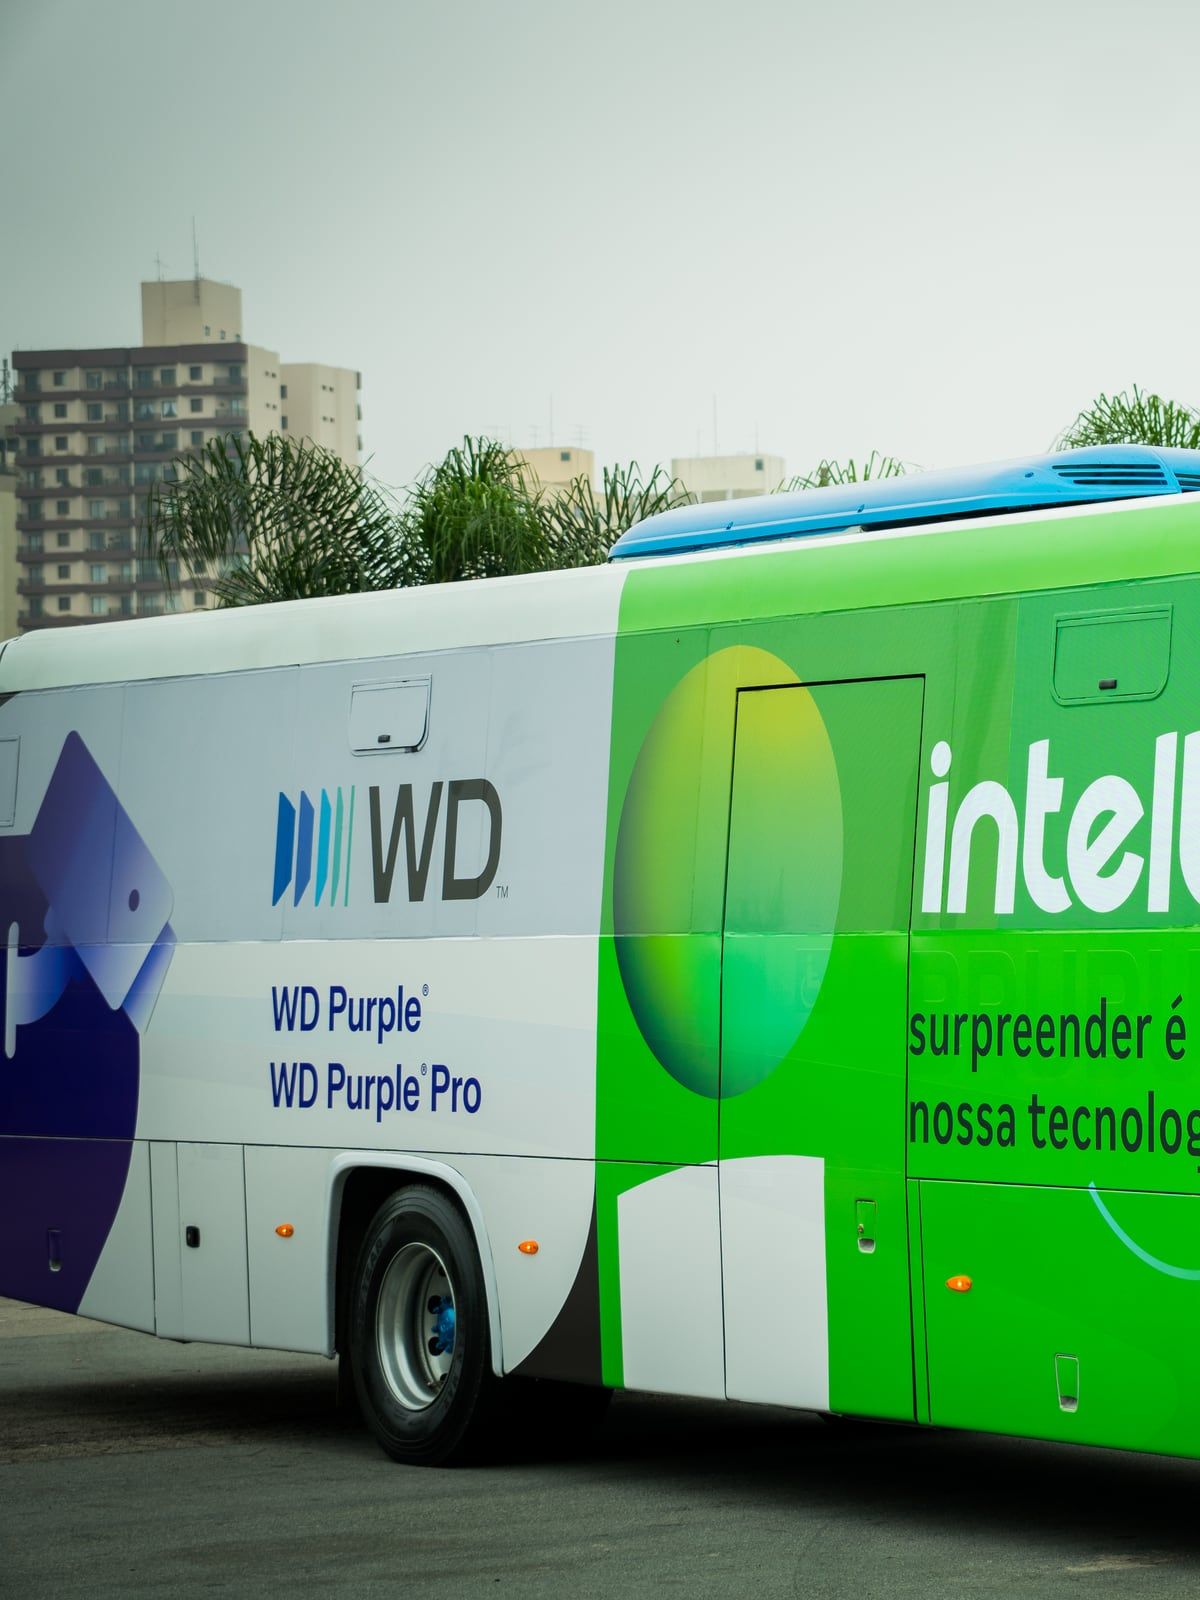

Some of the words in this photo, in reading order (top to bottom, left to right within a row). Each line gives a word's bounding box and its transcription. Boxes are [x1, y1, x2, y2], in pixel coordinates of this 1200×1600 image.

[369, 778, 503, 903] WD
[271, 985, 320, 1032] WD
[909, 997, 1153, 1073] surpreender
[1165, 994, 1187, 1061] é
[269, 1061, 319, 1109] WD
[431, 1064, 482, 1114] Pro
[909, 1101, 1016, 1148] nossa
